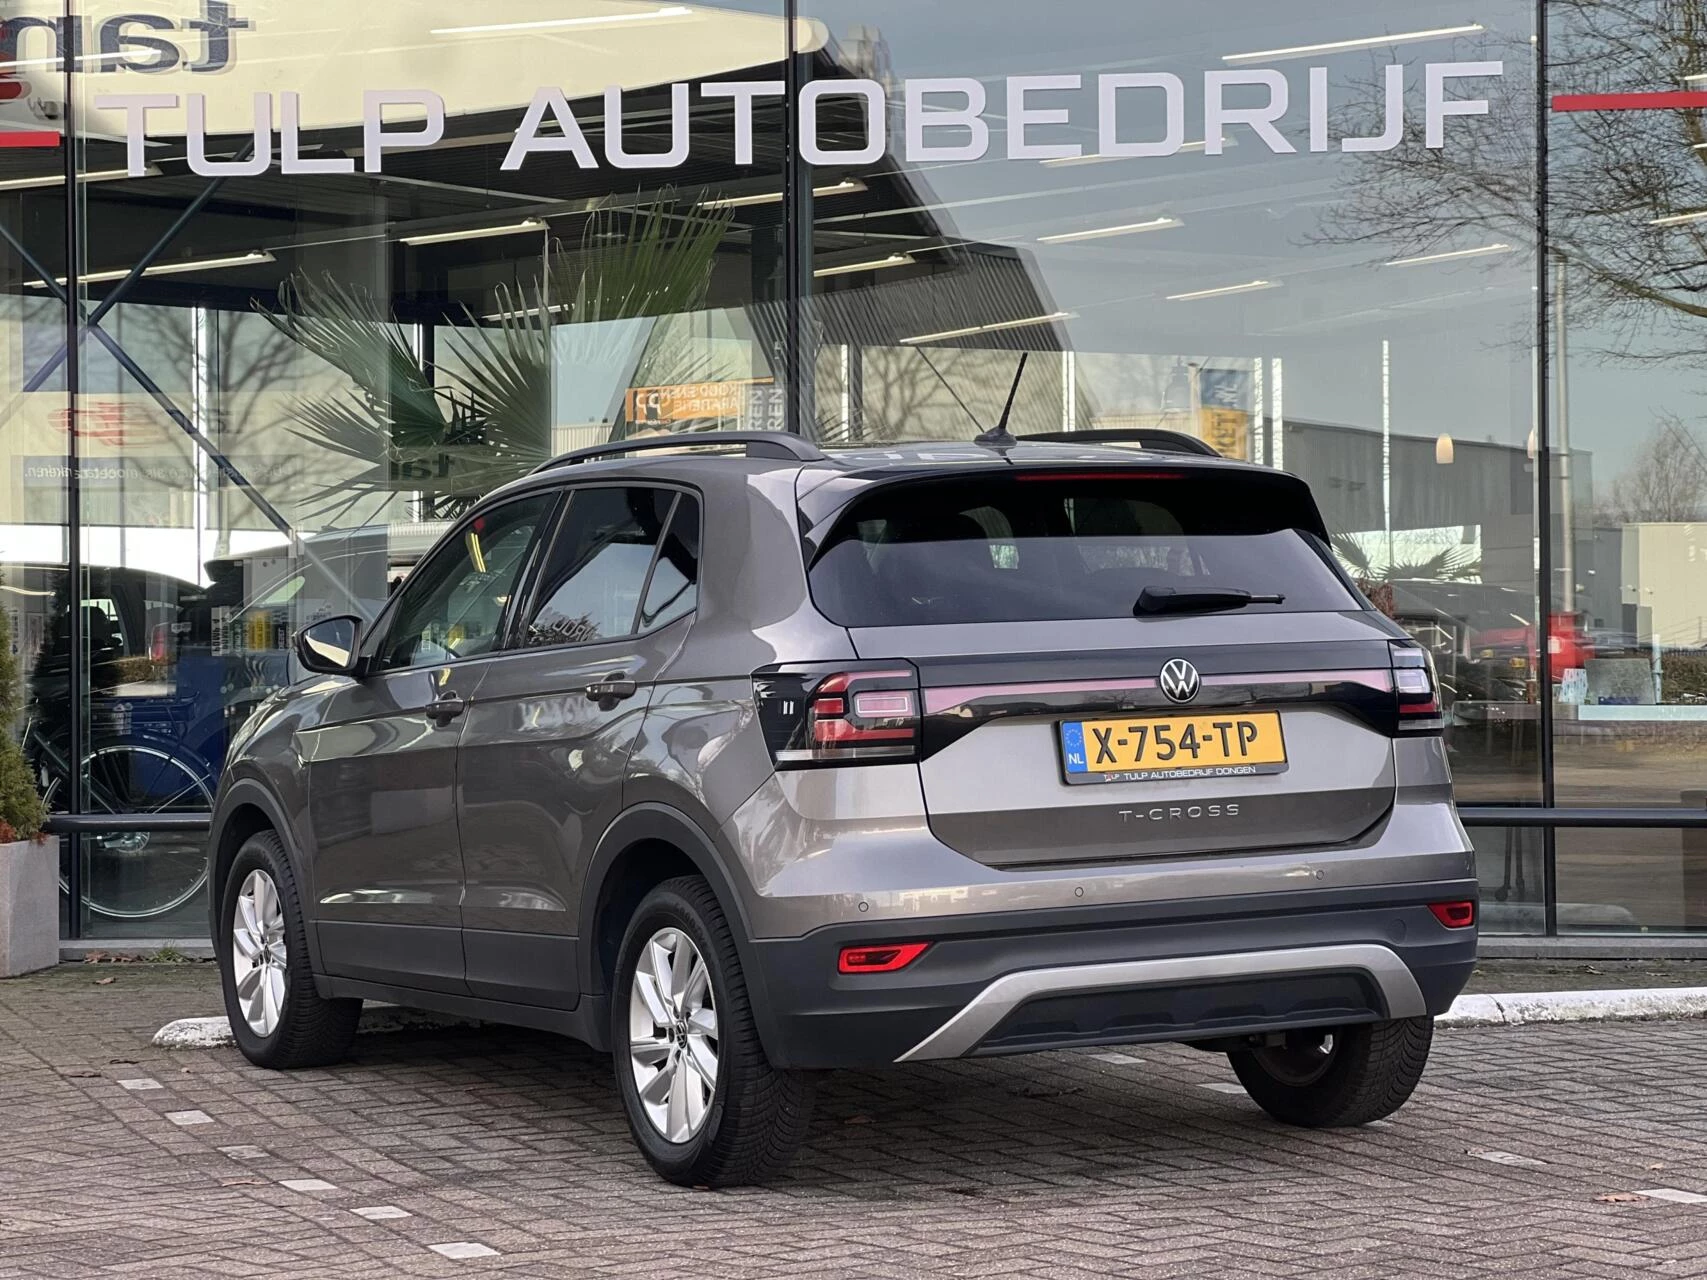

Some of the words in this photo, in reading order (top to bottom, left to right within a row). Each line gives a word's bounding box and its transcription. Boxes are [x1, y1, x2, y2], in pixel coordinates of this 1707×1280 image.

[94, 89, 445, 177] TULP
[500, 60, 1504, 171] AUTOBEDRIJF
[1092, 720, 1258, 765] X-754-TP
[1068, 753, 1085, 766] NL
[1123, 771, 1149, 781] TULP
[1150, 768, 1214, 779] AUTOBEDRIJF
[1215, 766, 1257, 776] DONGEN
[1118, 804, 1240, 823] T-CROSS
